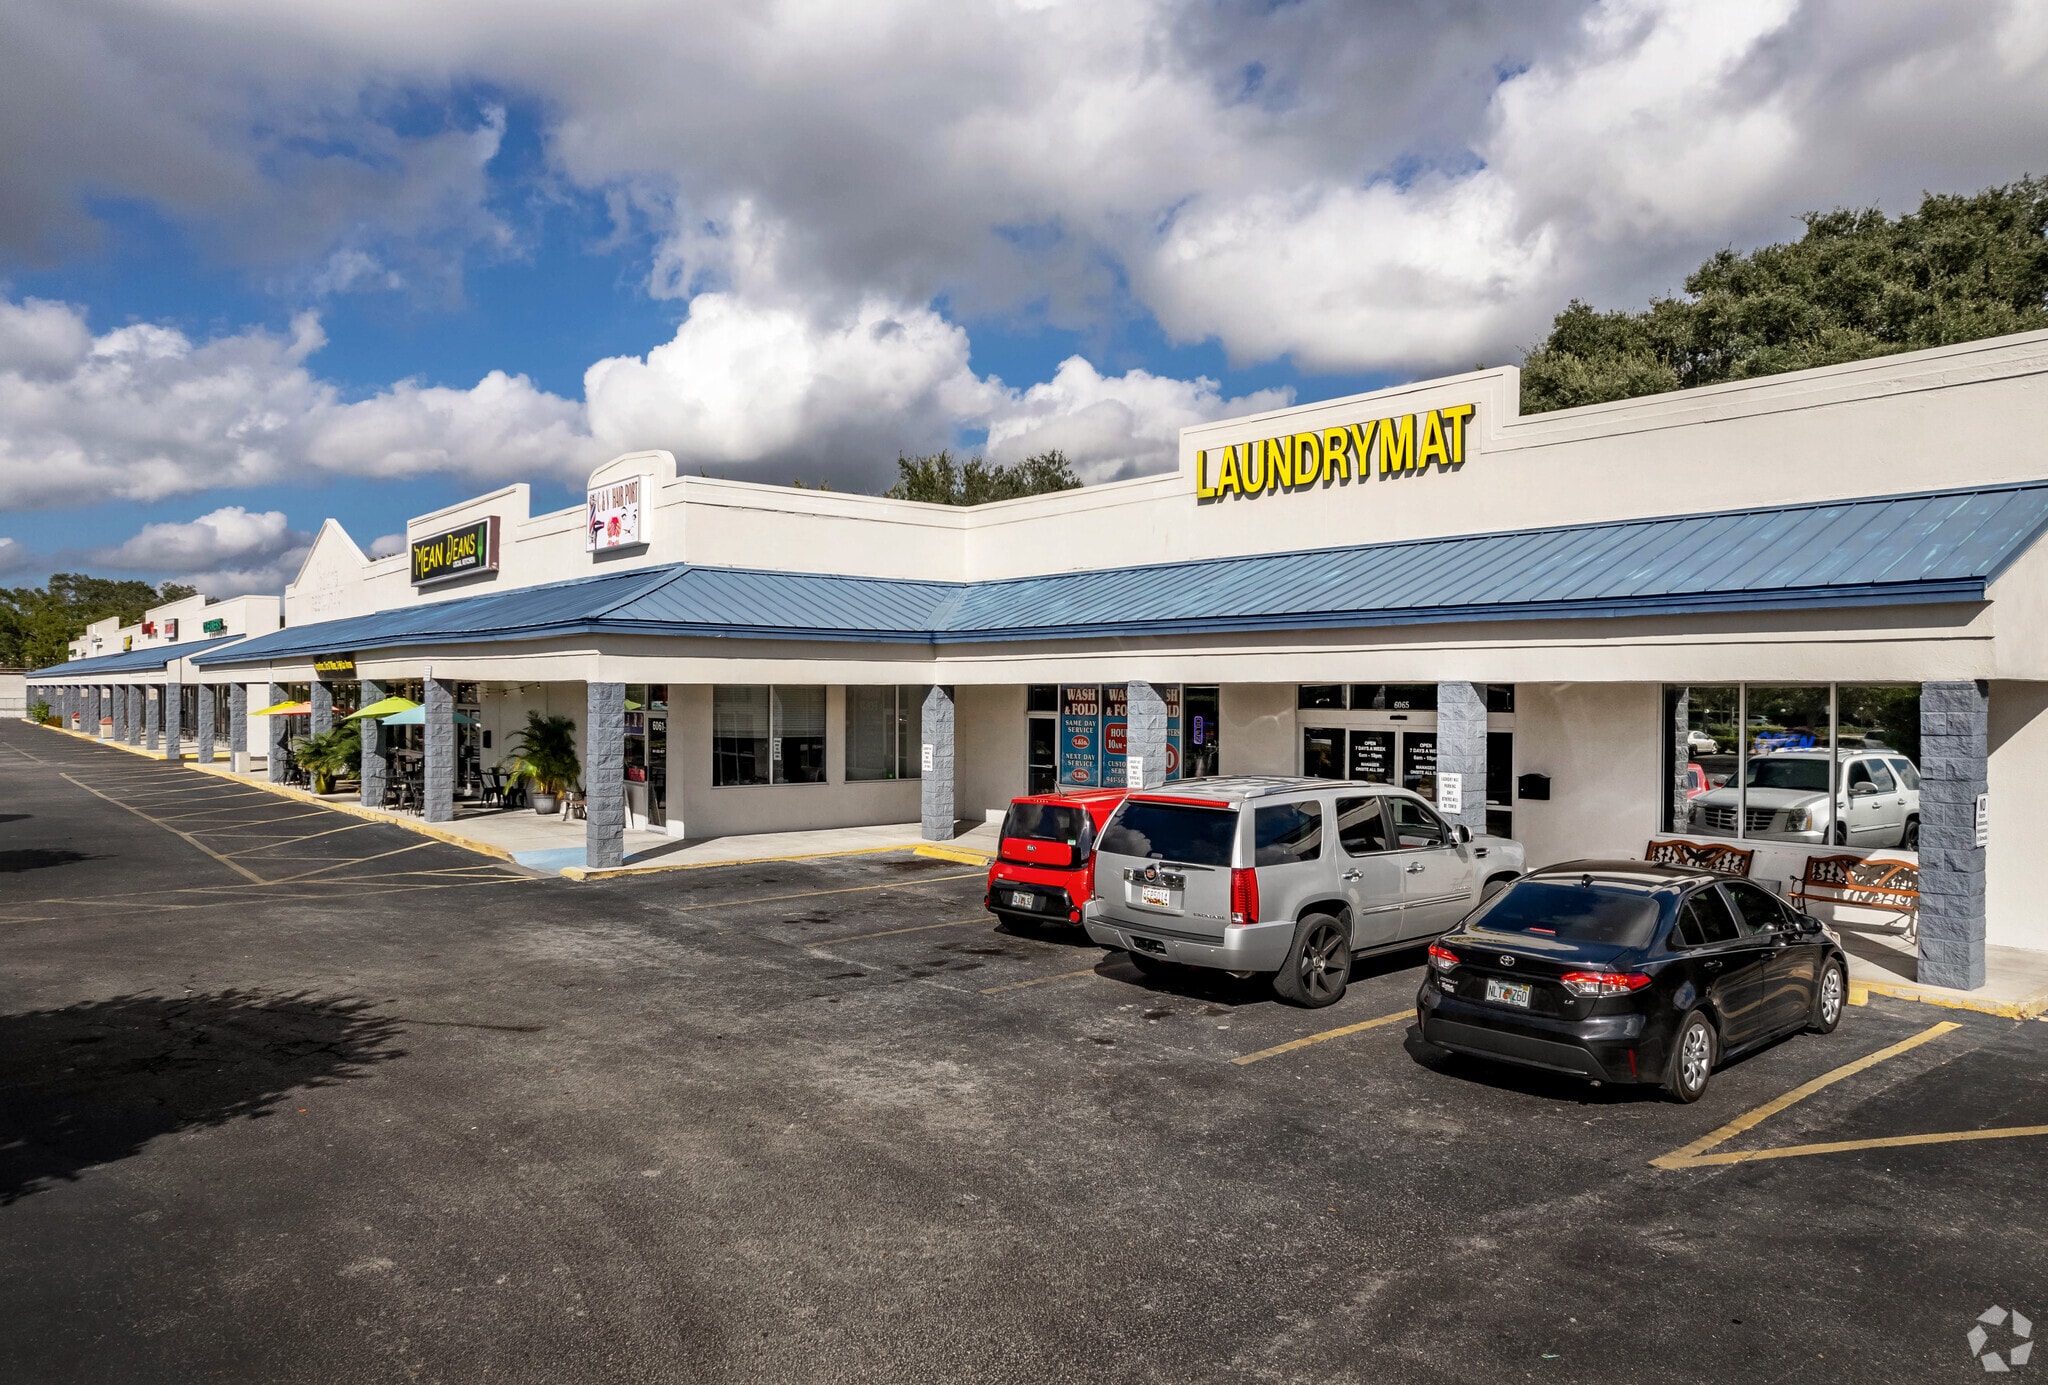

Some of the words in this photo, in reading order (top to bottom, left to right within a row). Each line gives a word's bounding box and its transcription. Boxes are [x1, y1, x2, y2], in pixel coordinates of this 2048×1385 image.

[1197, 404, 1474, 499] LAUNDRYMAT
[625, 481, 638, 505] PORT
[413, 542, 443, 579] MEAN
[446, 534, 476, 565] DEANS
[1067, 688, 1096, 701] WASH
[1108, 688, 1128, 701] WAS
[1166, 688, 1178, 702] SH
[1064, 705, 1071, 715] &
[1072, 703, 1098, 716] FOLD
[1106, 706, 1112, 716] &
[1114, 704, 1128, 717] FO
[1168, 705, 1180, 718] LD
[1067, 726, 1094, 734] SERVICE
[1111, 728, 1128, 738] HOU
[1167, 728, 1180, 737] TERS
[1754, 731, 1816, 753] OPEN
[1067, 760, 1094, 768] SERVICE
[1107, 760, 1127, 768] CUSTO
[1166, 750, 1175, 769] 0
